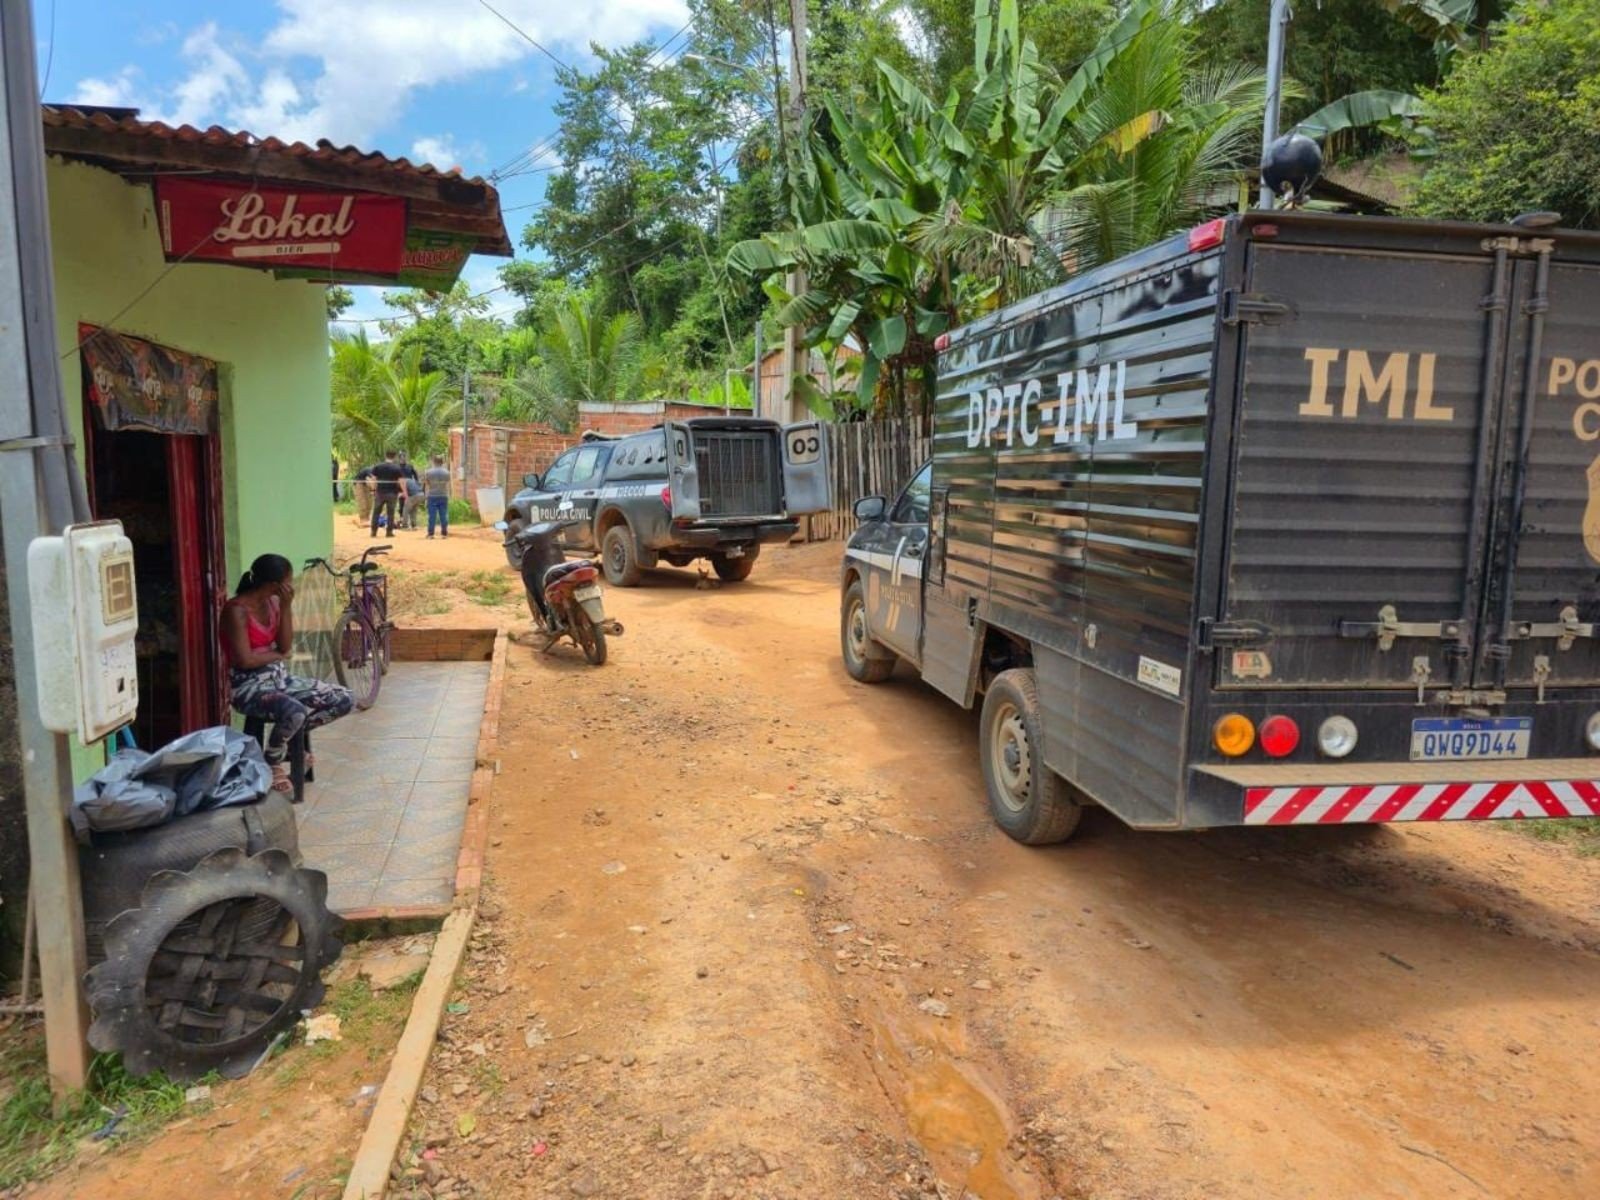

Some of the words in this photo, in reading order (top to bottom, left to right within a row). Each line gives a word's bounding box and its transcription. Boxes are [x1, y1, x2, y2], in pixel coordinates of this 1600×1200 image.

[213, 193, 354, 242] Lokal
[967, 360, 1137, 448] DPTC-IML
[1299, 348, 1454, 420] IML
[569, 507, 592, 521] CIVIL
[1424, 731, 1517, 757] QWQ9D44
